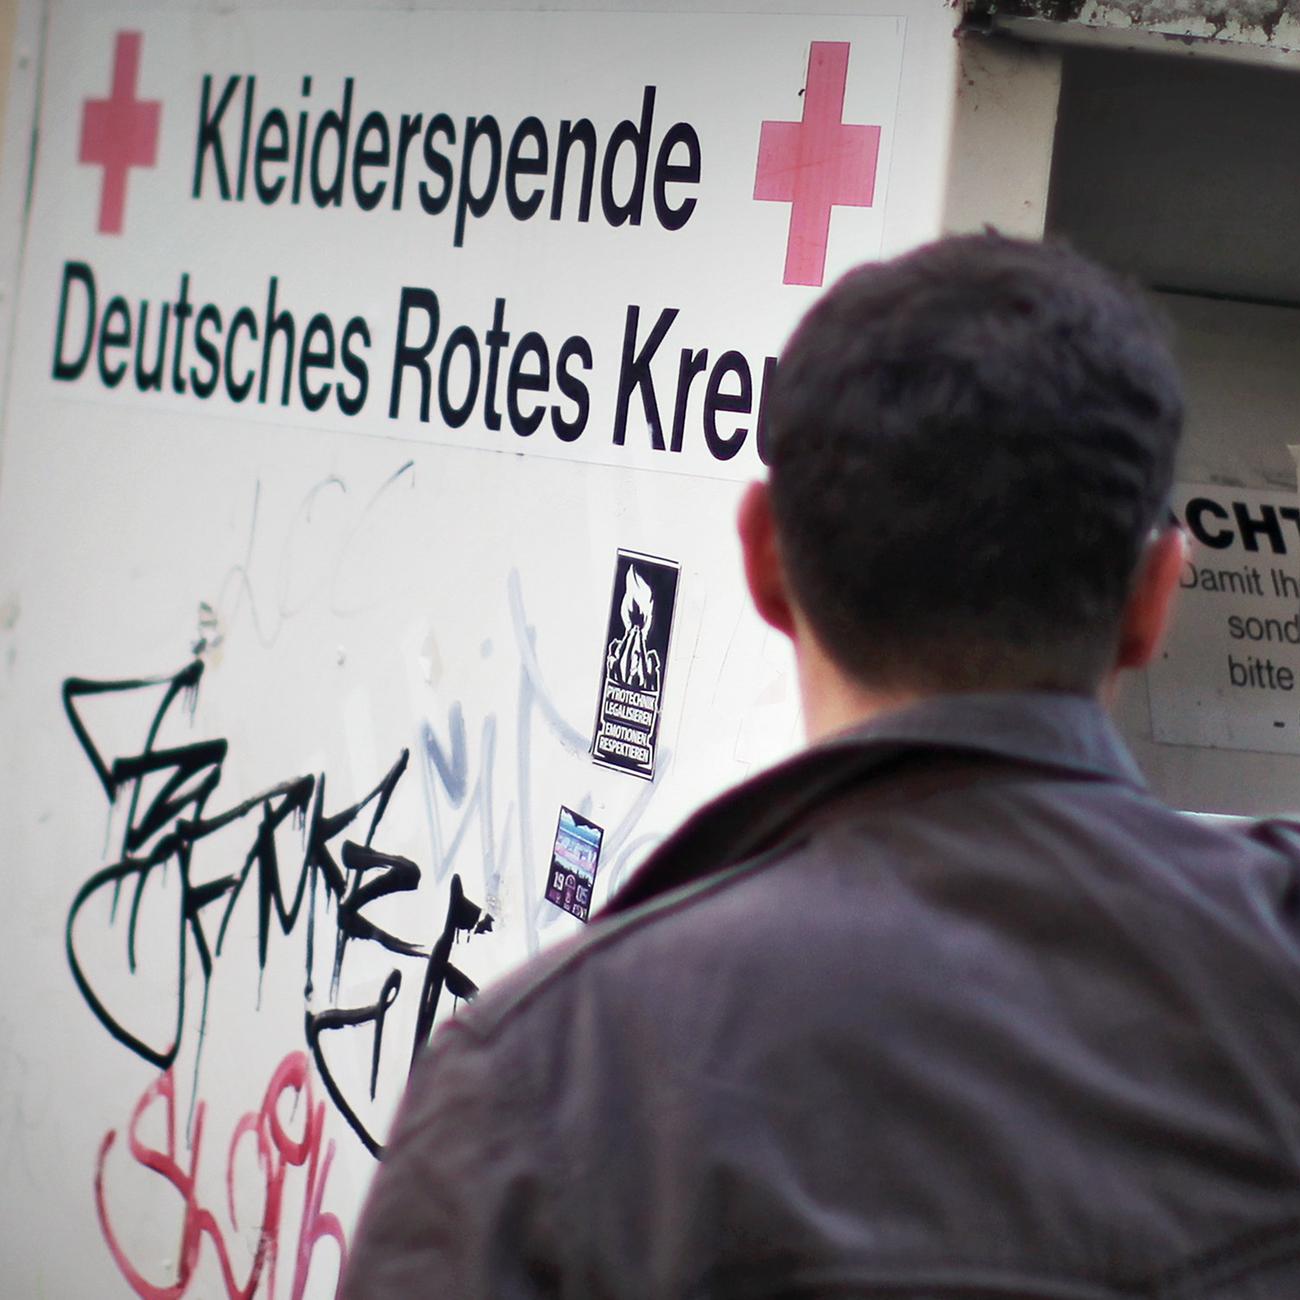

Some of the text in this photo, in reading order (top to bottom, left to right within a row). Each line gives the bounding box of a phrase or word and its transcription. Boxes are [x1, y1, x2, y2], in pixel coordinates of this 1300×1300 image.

[193, 75, 702, 248] Kleiderspende
[52, 261, 371, 416] Deutsches
[389, 286, 592, 442] Rotes
[1228, 655, 1294, 692] bitte
[606, 685, 656, 711] PYROTECHNIK
[605, 700, 653, 727] LEGALISIEREN
[605, 722, 649, 747] EMOTIONEN
[599, 736, 650, 763] RESPEKTIEREN
